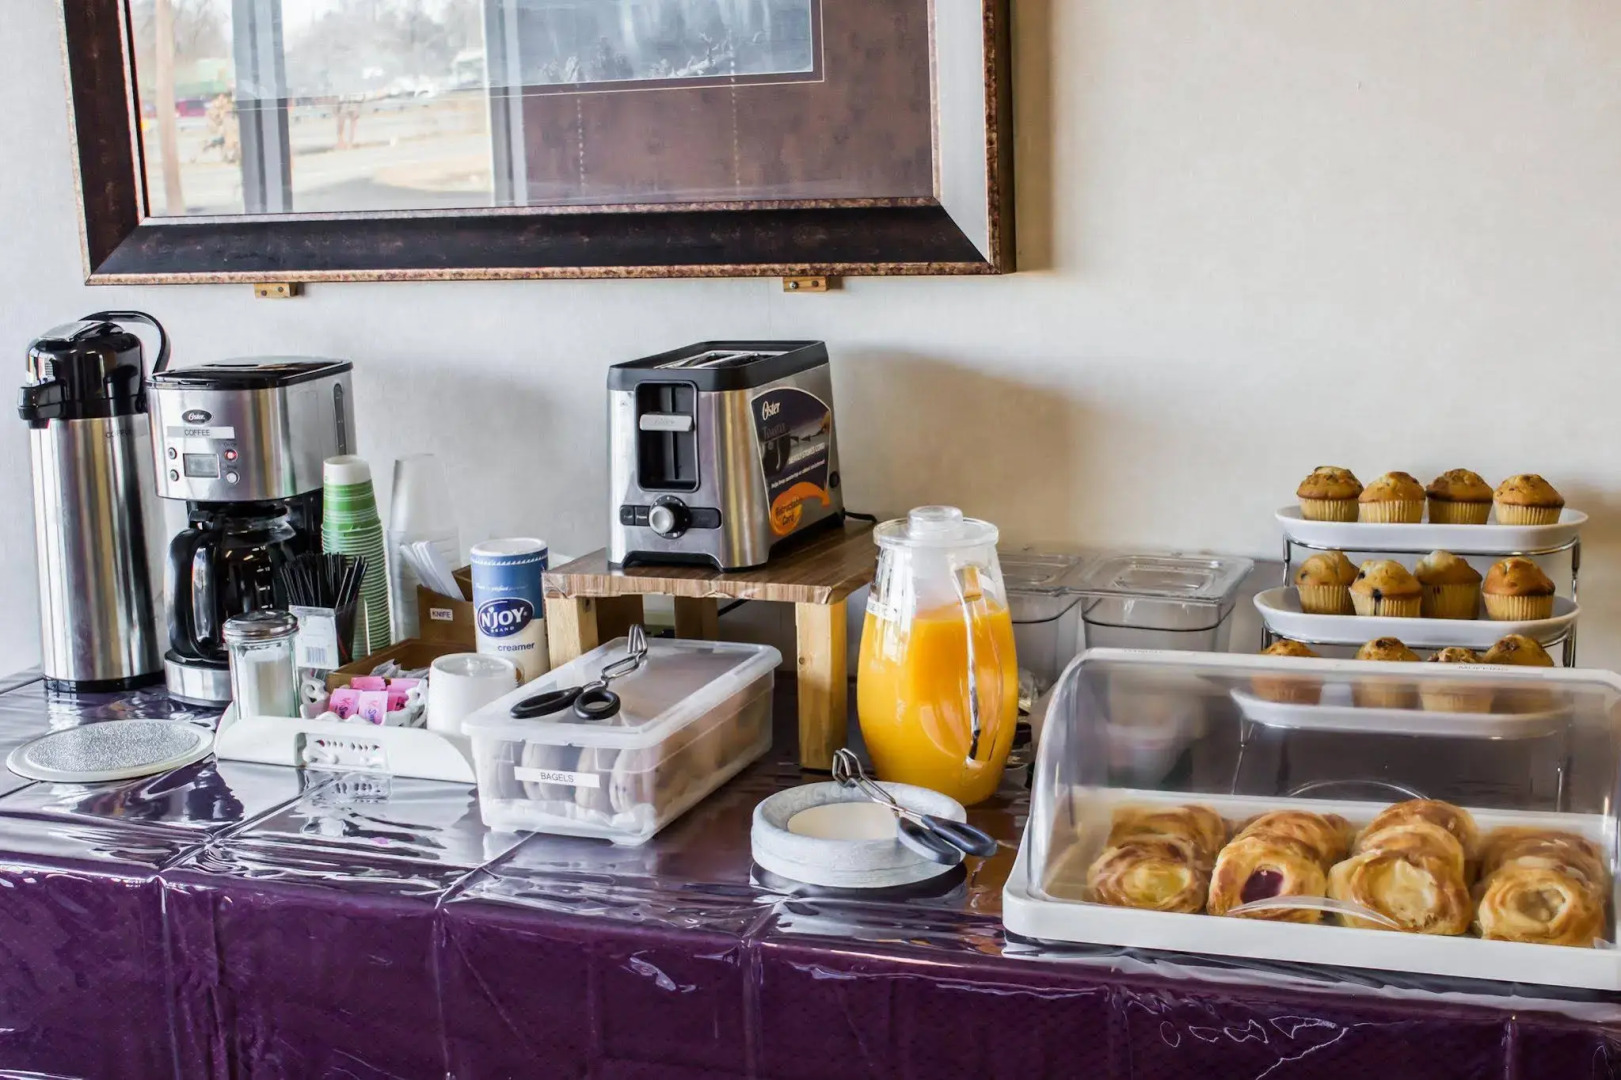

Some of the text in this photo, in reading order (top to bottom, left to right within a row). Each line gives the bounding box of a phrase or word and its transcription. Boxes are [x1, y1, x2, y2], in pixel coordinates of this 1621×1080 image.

[762, 400, 780, 420] Oster
[188, 412, 205, 420] Oster
[184, 429, 210, 437] COFFEE
[432, 609, 452, 619] KNIFE
[497, 642, 535, 652] creamer
[540, 772, 574, 783] BAGELS
